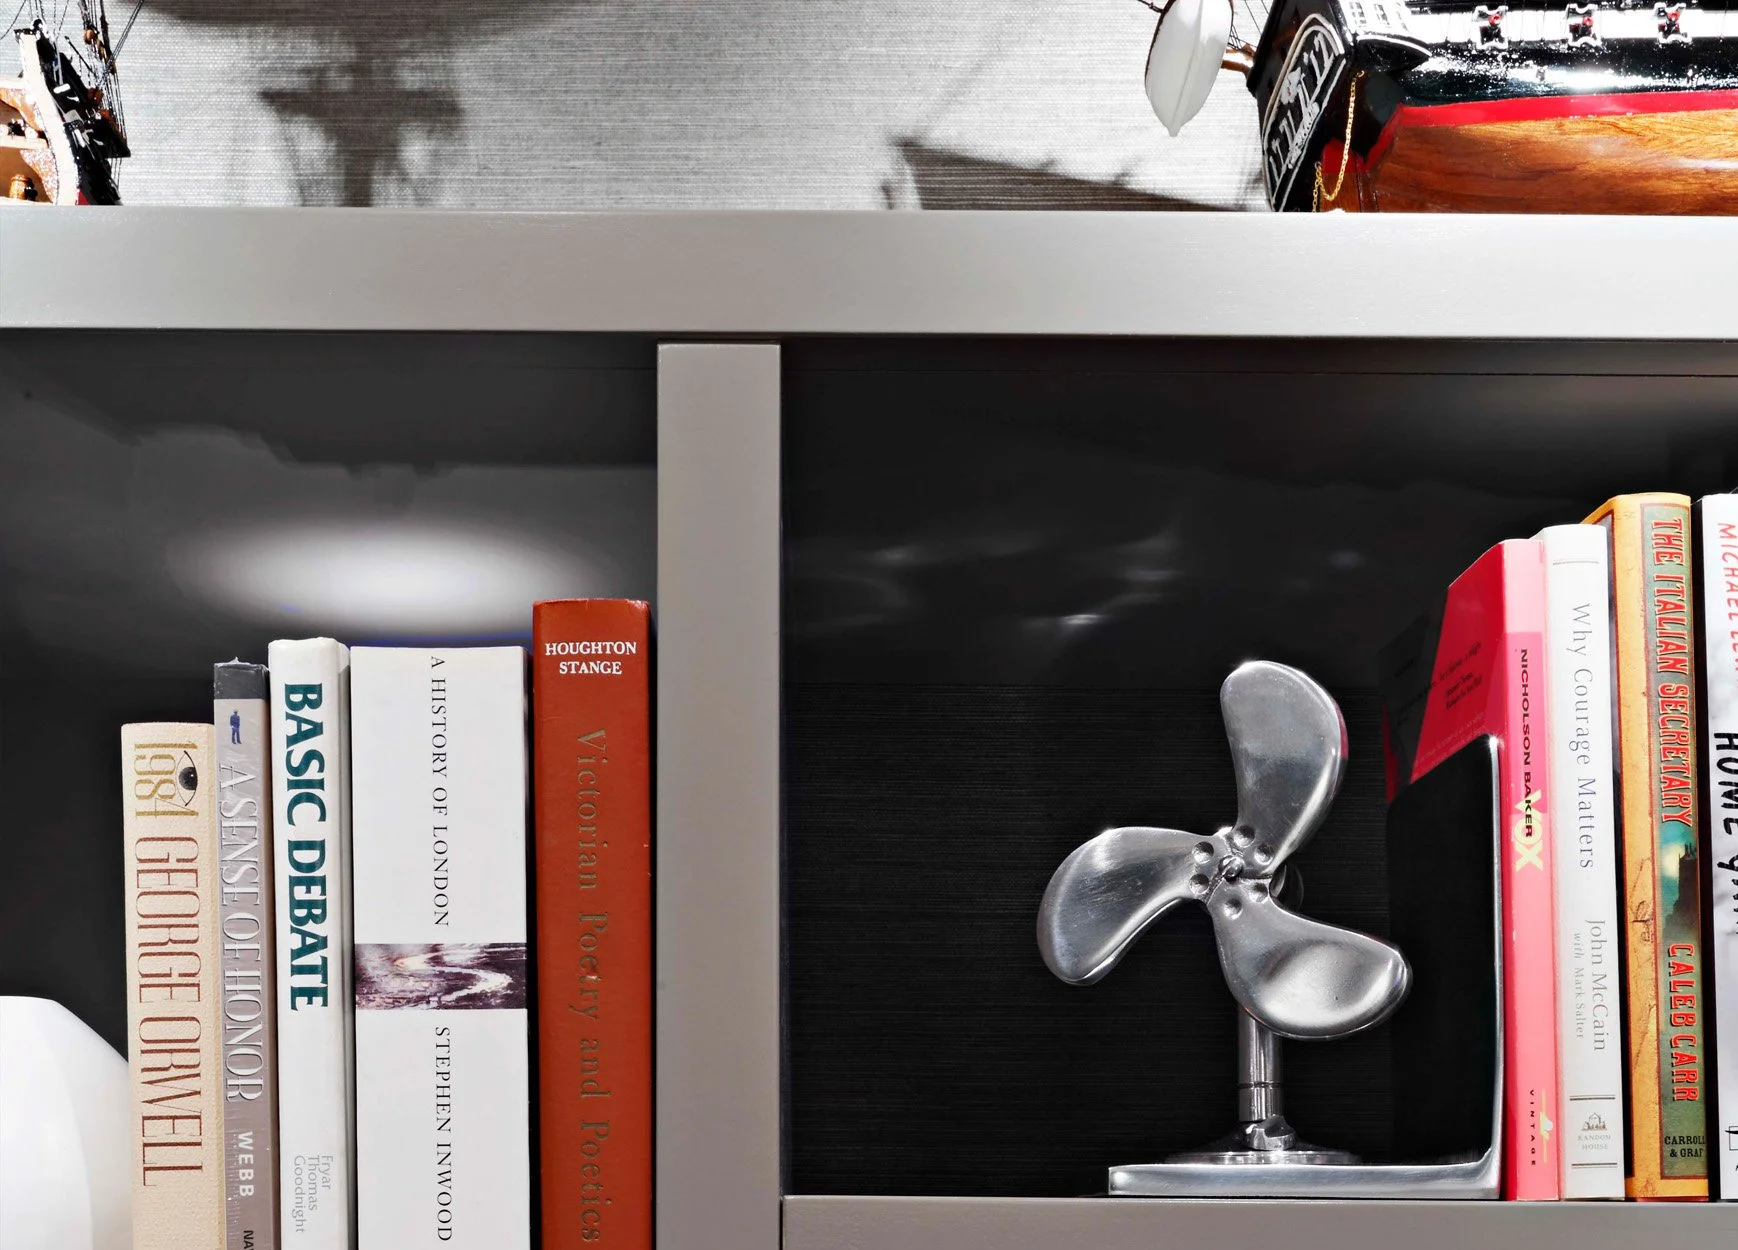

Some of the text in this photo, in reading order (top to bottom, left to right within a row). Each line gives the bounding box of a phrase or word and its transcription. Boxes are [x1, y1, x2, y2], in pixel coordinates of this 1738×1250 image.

[545, 641, 637, 656] HOUGHTON
[559, 661, 623, 675] STANGE
[1652, 517, 1693, 827] THE ITALIAN SECRETARY
[430, 656, 449, 927] A HISTORY OF LONDON
[1520, 648, 1533, 837] NICHOLSON BAKER
[1568, 603, 1595, 869] Why Courage Matters
[284, 683, 329, 1011] BASIC DEBATE
[1514, 790, 1543, 872] VOX
[134, 741, 203, 1187] 1984 GEORGE ORWELL
[219, 764, 264, 1103] A SENSE OF HONOR
[569, 728, 612, 1243] Victorian Poetry and Poetics
[1573, 932, 1585, 1040] with Mark Salter
[1585, 919, 1608, 1051] John McCain
[1667, 943, 1699, 1102] CALEB CARR
[238, 1131, 255, 1197] WEBB
[291, 1155, 306, 1233] Goodnight
[307, 1155, 318, 1211] Thomas
[321, 1155, 334, 1191] Fryar
[435, 1027, 453, 1242] STEPHEN INWOOD
[1577, 1133, 1612, 1141] RANDOM
[1582, 1142, 1609, 1151] HOUSE
[1669, 1148, 1678, 1158] &
